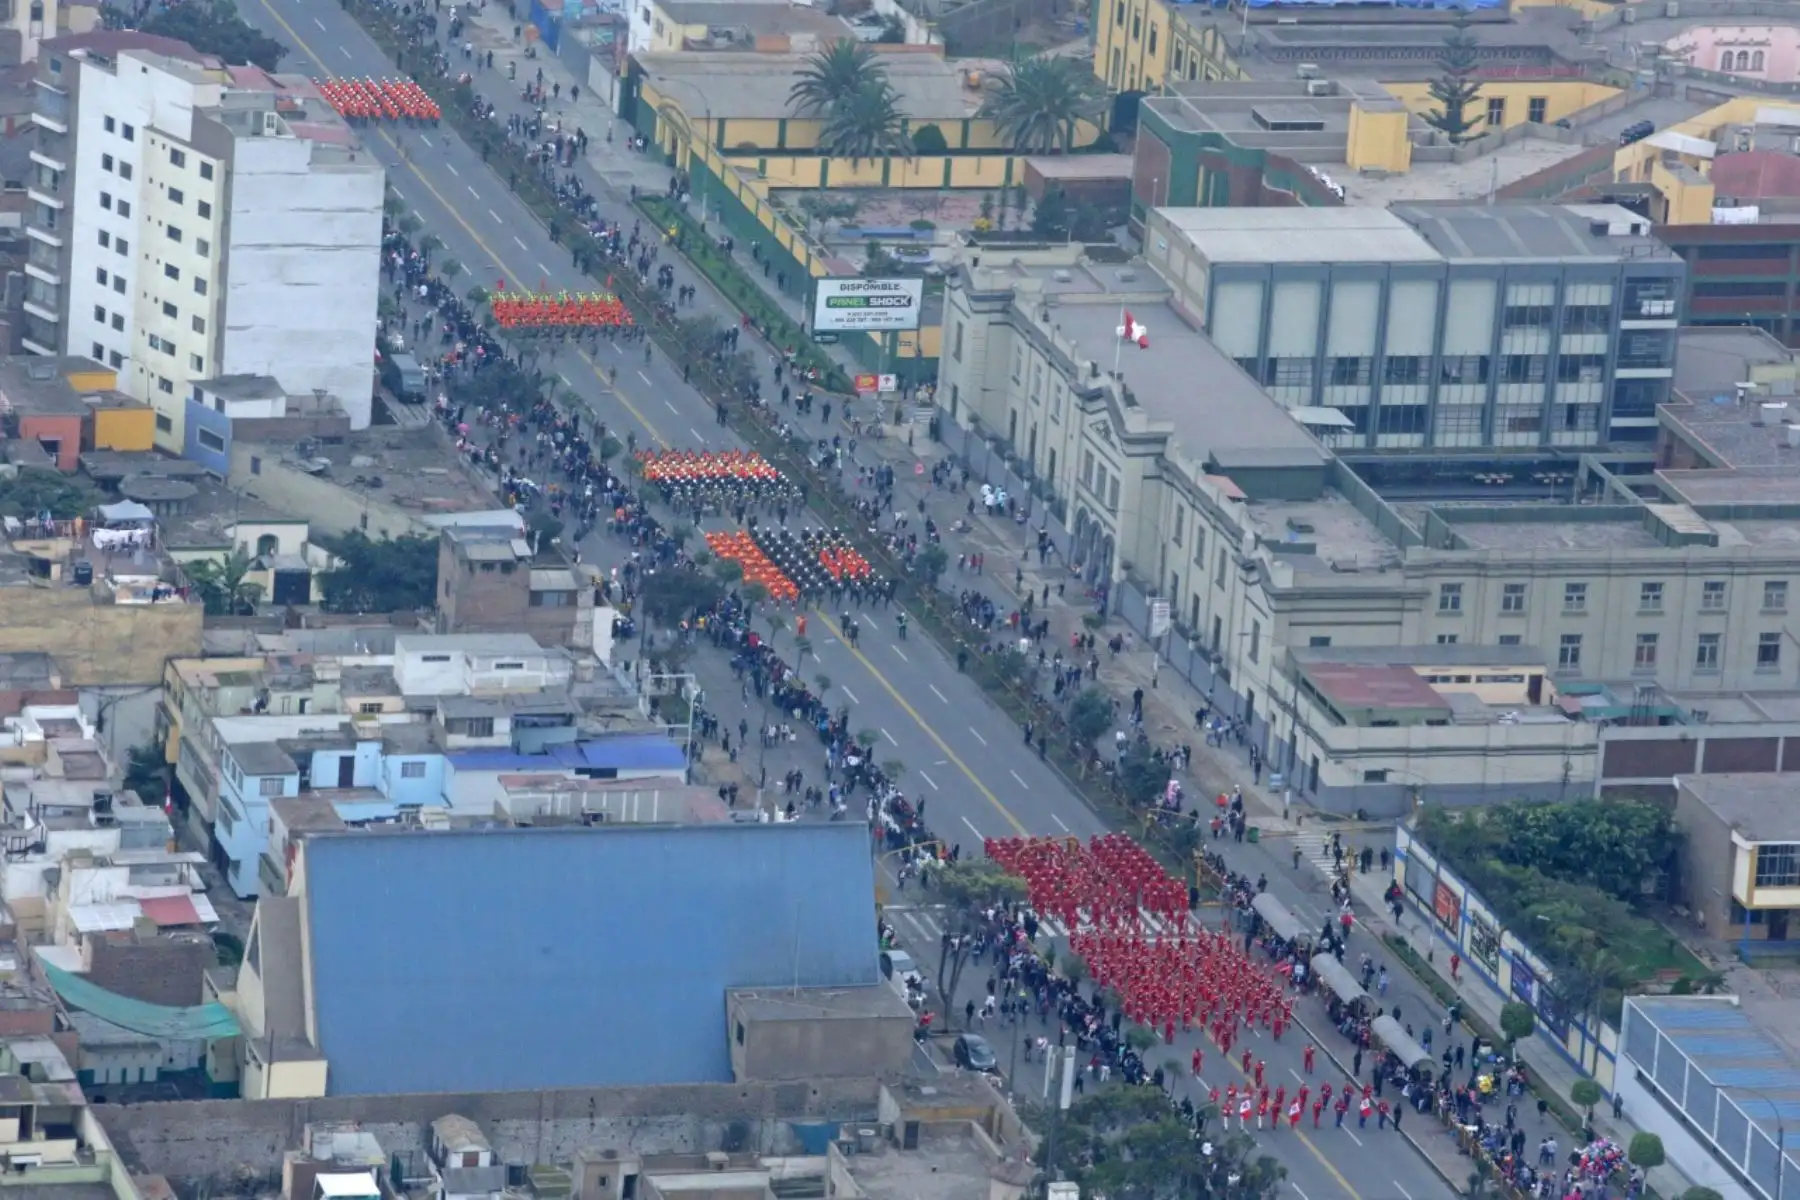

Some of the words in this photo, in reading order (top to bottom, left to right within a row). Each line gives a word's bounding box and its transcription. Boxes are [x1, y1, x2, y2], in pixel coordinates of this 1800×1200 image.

[840, 283, 900, 291] DISPONIBLE
[830, 297, 867, 306] PANEL
[869, 296, 909, 306] SHOCK
